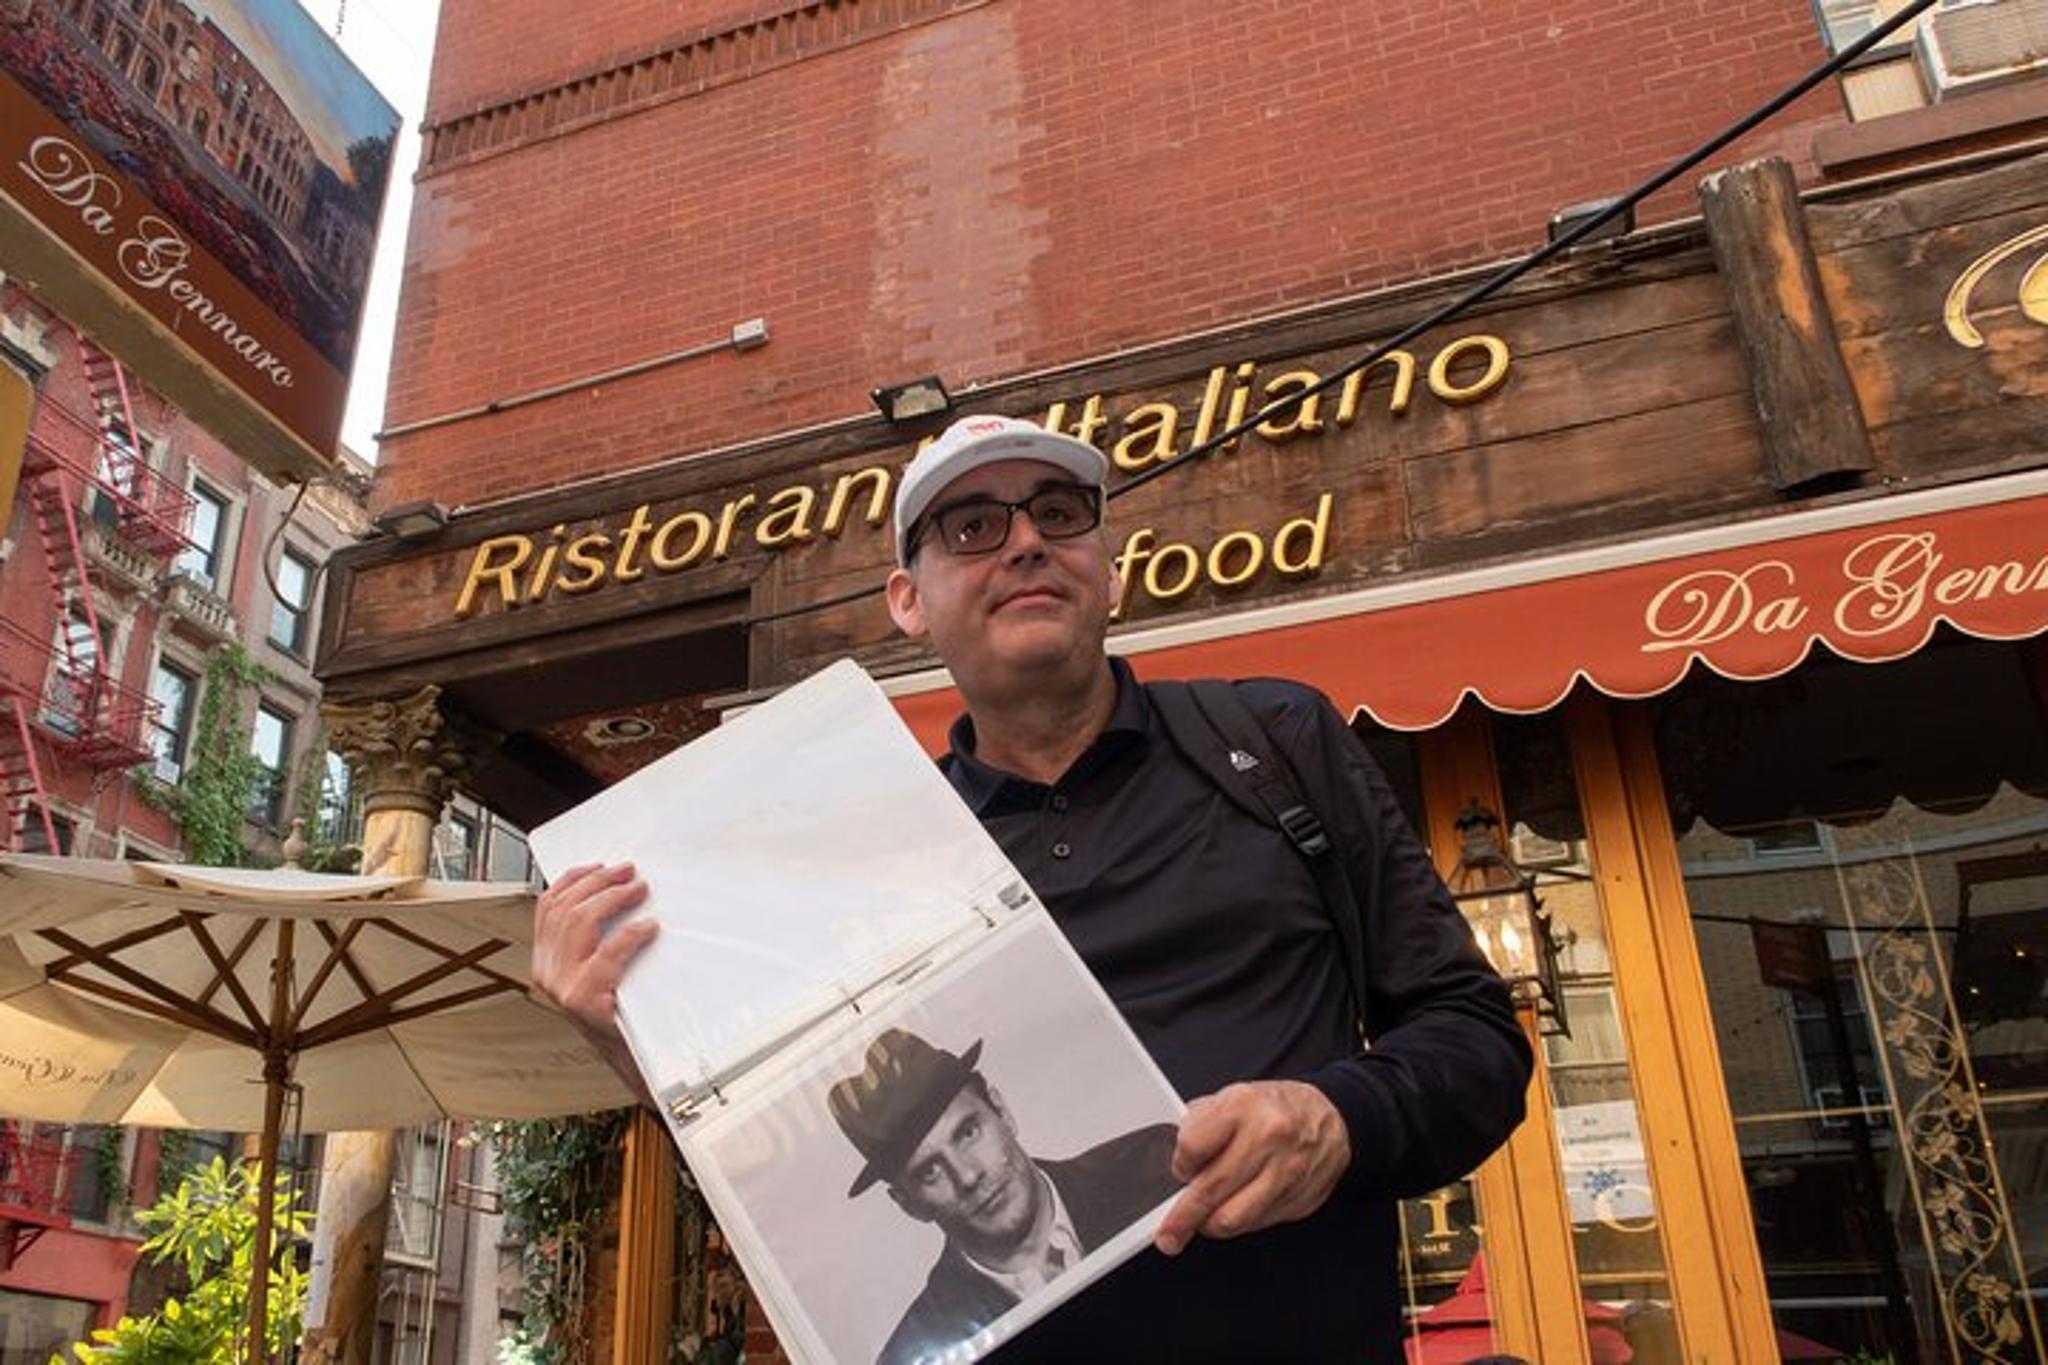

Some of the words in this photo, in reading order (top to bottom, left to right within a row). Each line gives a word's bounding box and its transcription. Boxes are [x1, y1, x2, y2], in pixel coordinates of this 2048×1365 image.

[18, 136, 122, 236] Da
[117, 214, 295, 390] Gennaro
[455, 436, 934, 619] Ristoran
[1641, 560, 1808, 653] Da
